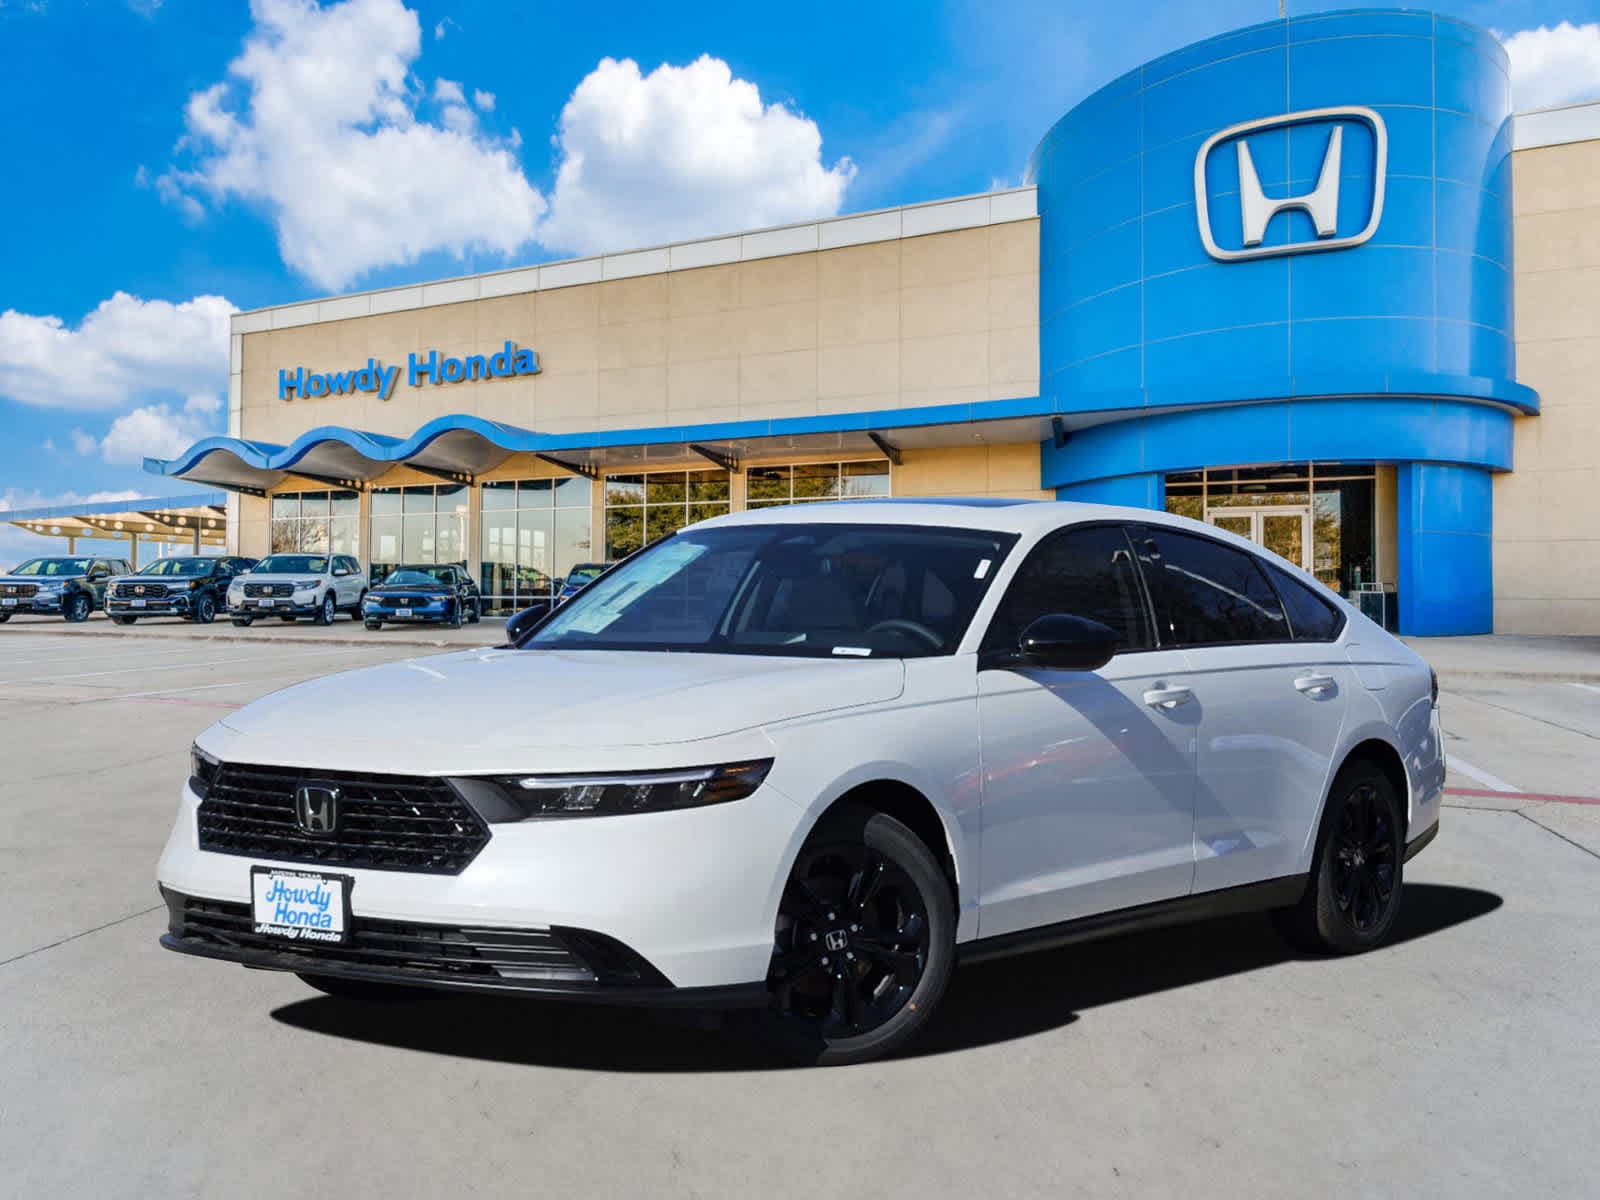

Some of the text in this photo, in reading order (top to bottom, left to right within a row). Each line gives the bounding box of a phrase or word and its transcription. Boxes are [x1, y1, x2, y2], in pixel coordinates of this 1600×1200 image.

[278, 340, 540, 401] Howdy Honda
[266, 880, 331, 912] Howdy
[274, 903, 332, 928] Honda
[255, 923, 342, 942] Howdy Honda
